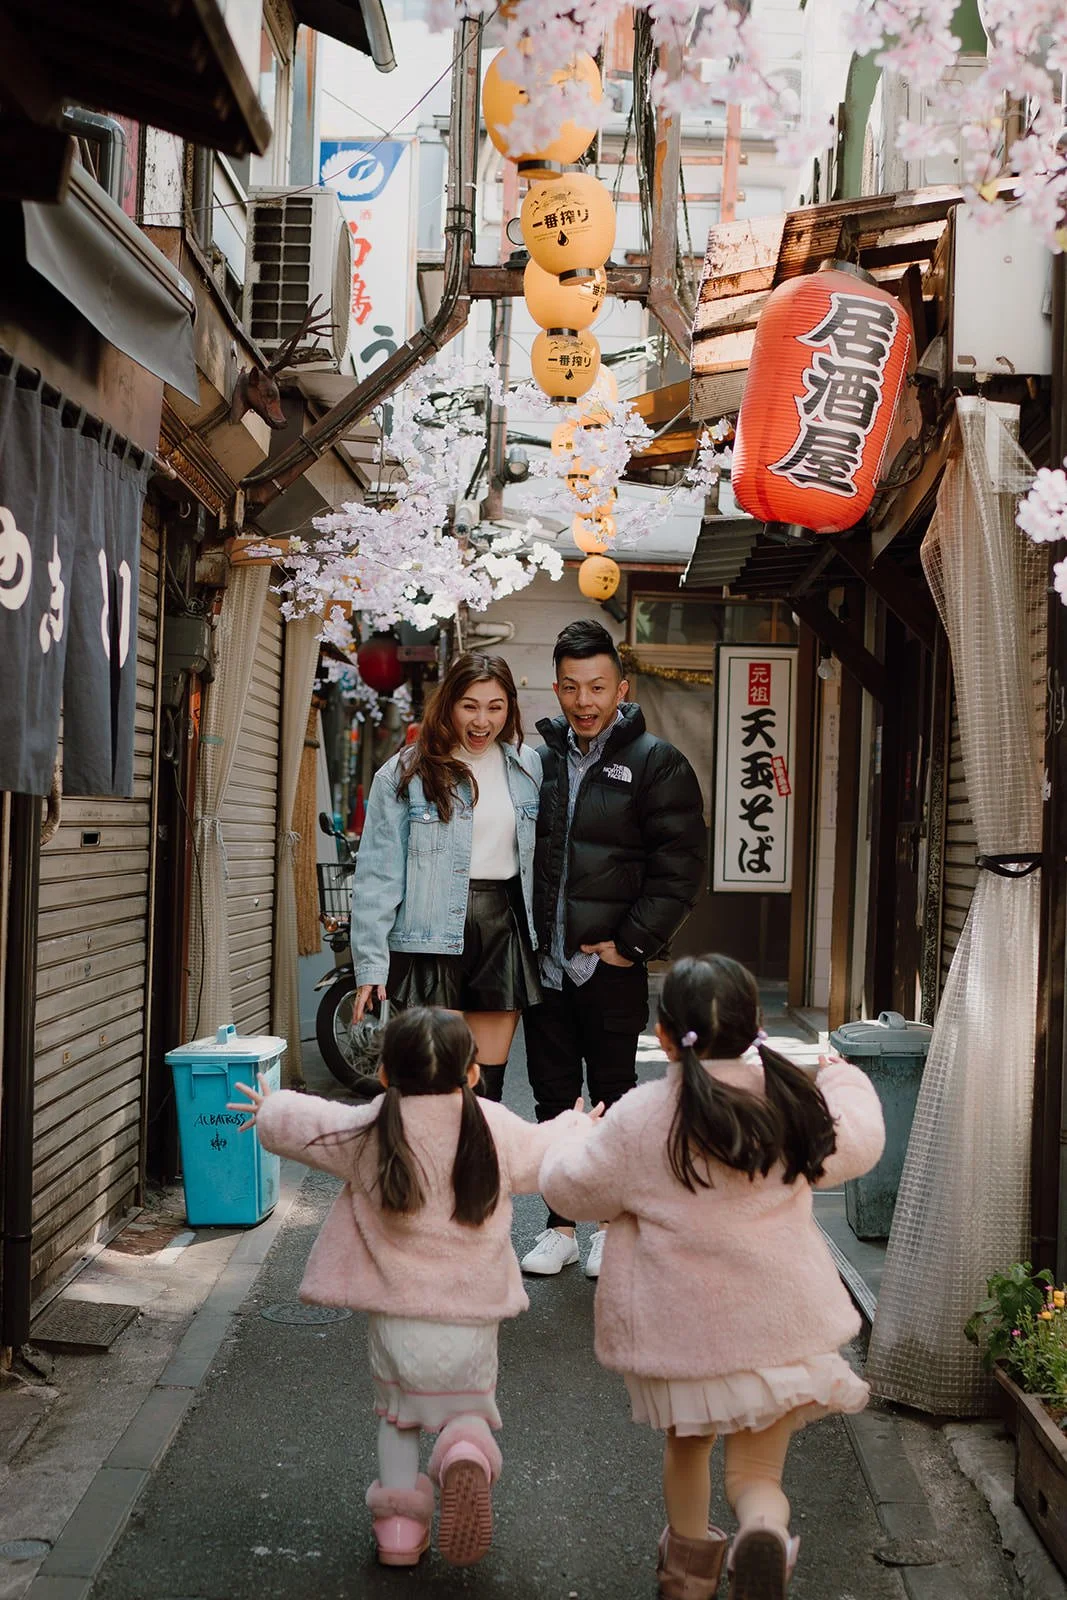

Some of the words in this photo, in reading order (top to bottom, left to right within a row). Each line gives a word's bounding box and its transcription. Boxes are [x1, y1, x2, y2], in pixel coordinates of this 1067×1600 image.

[532, 209, 589, 229] 一番搾り
[548, 354, 591, 368] 一番搾り
[767, 292, 899, 498] 居酒屋
[750, 667, 769, 702] 元祖
[738, 708, 777, 874] 天玉そば
